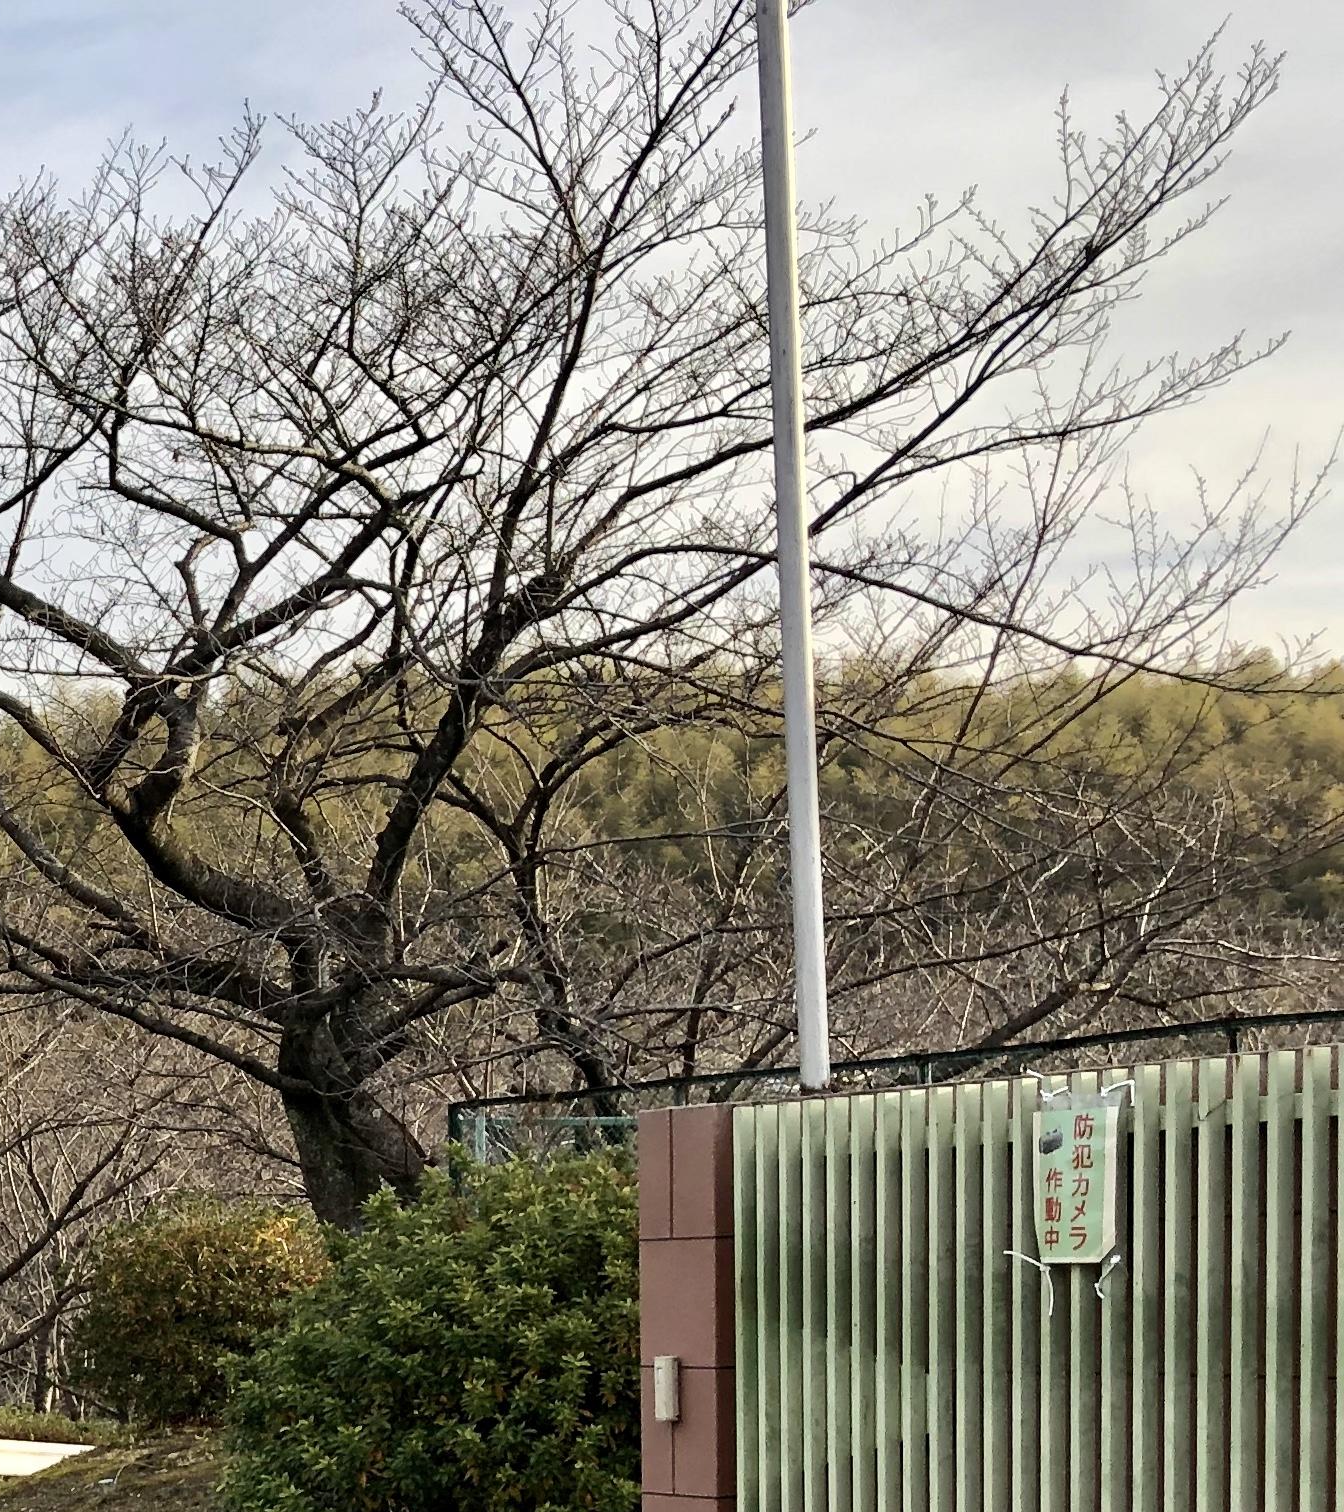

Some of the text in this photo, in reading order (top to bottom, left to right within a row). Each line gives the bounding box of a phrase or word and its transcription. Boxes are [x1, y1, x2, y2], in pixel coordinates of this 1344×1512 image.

[1044, 1167, 1064, 1251] 作動中
[1070, 1113, 1095, 1250] 防犯カメラ
